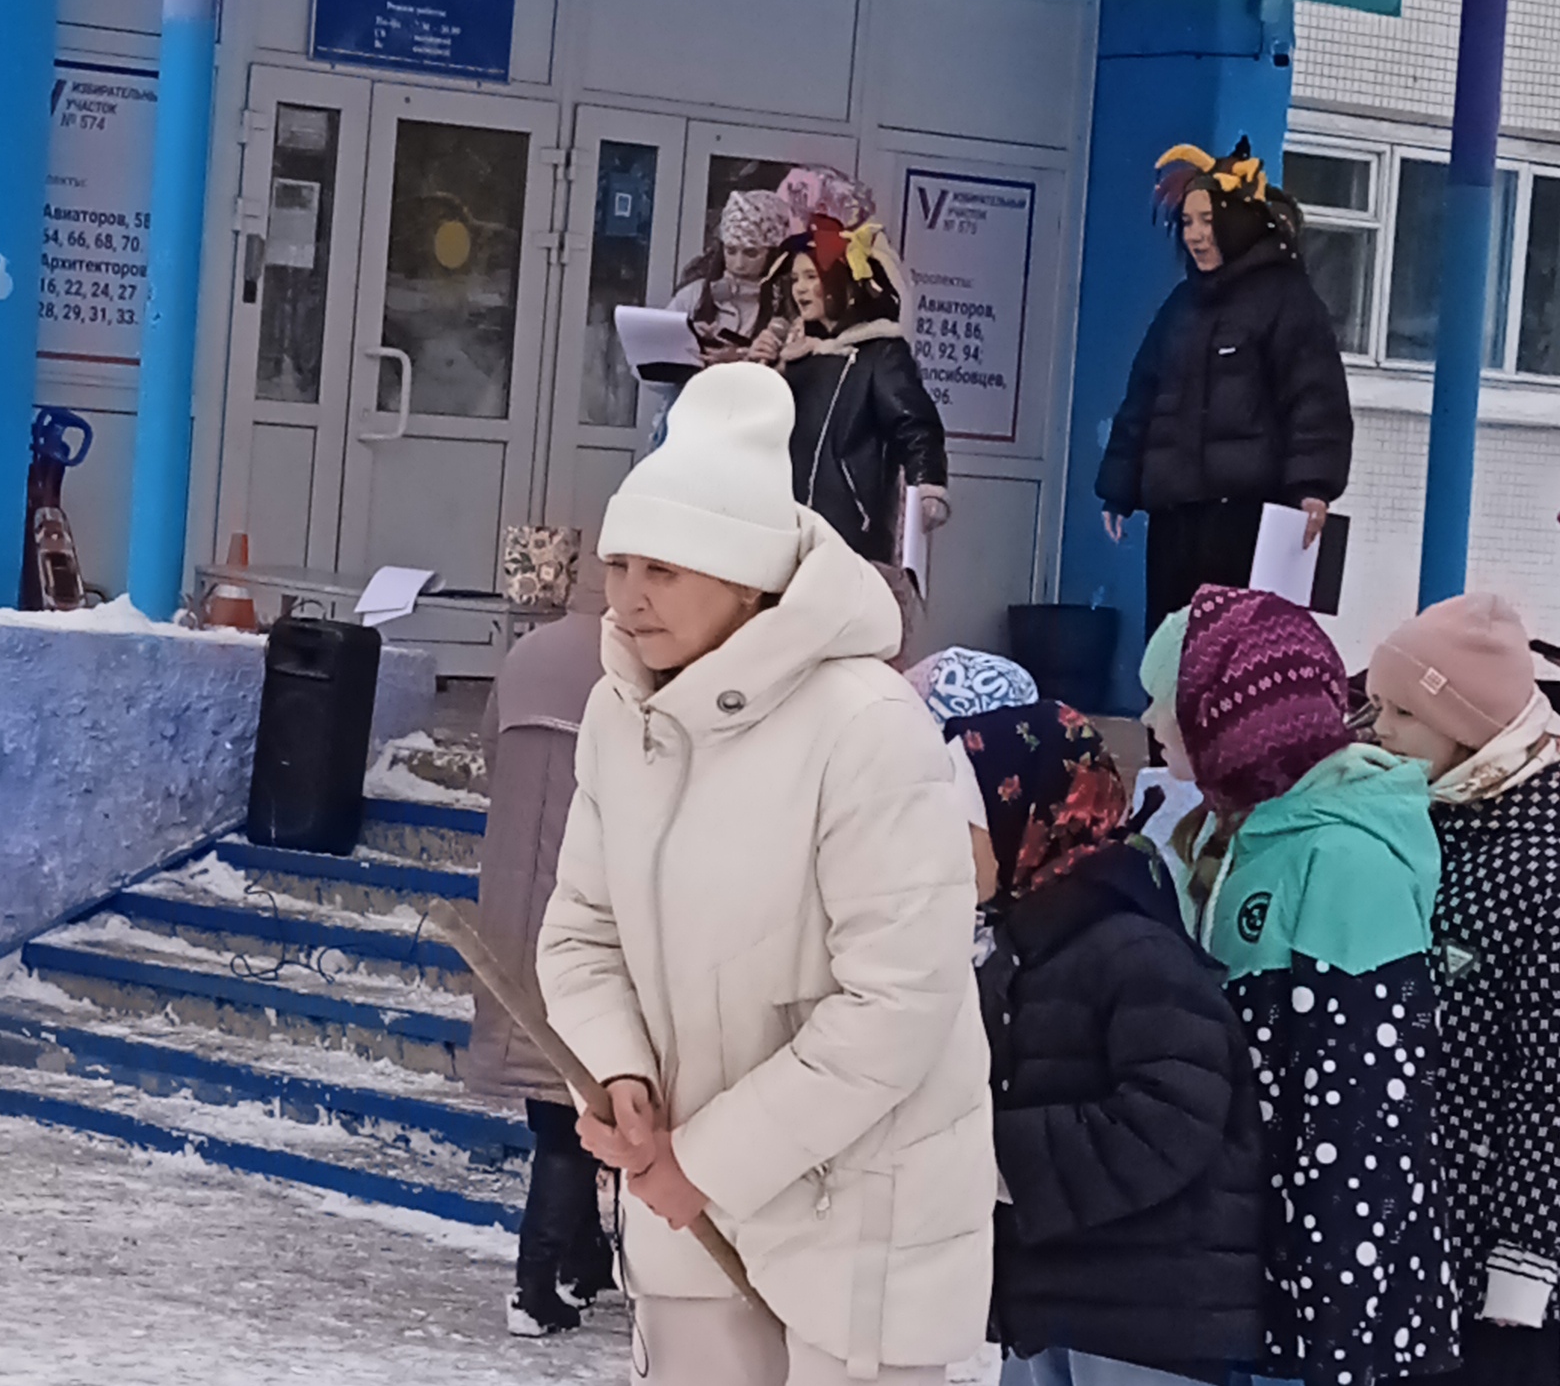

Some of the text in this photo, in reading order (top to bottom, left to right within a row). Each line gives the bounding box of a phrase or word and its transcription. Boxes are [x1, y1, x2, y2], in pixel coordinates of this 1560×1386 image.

[66, 99, 118, 114] УЧАСТОК
[60, 113, 106, 130] № 574
[43, 203, 130, 229] Авиаторов,
[67, 230, 90, 250] 66,
[94, 233, 117, 253] 68,
[64, 279, 87, 300] 22,
[91, 281, 114, 302] 24,
[62, 303, 85, 324] 29,
[89, 305, 112, 326] 31,
[917, 294, 996, 321] Авиаторов,
